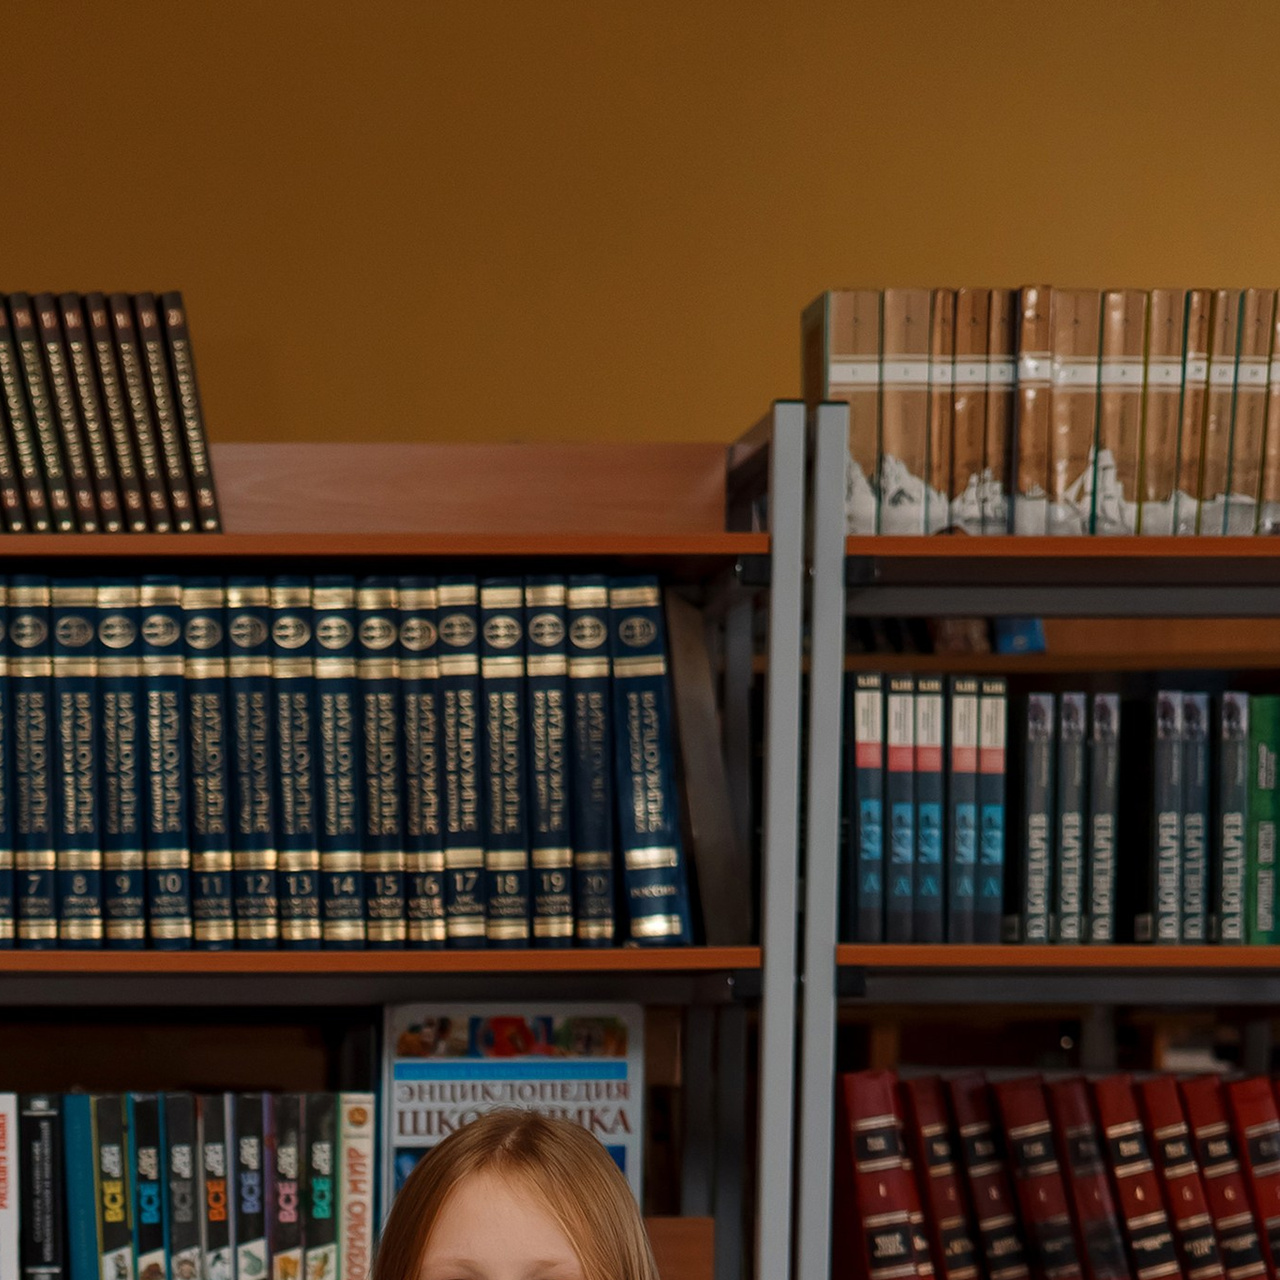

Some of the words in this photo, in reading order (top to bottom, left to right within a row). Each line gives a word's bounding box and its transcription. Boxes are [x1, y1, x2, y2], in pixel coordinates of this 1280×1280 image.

[29, 692, 48, 834] ЭНЦИКЛОПЕДИЯ
[76, 692, 95, 834] ЭНЦИКЛОПЕДИЯ
[117, 692, 137, 834] ЭНЦИКЛОПЕДИЯ
[161, 691, 181, 833] ЭНЦИКЛОПЕДИЯ
[202, 692, 226, 834] ЭНЦИКЛОПЕДИЯ
[250, 691, 270, 834] ЭНЦИКЛОПЕДИЯ
[293, 692, 312, 834] ЭНЦИКЛОПЕДИЯ
[334, 692, 356, 834] ЭНЦИКЛОПЕДИЯ
[377, 693, 399, 835] ЭНЦИКЛОПЕДИЯ
[419, 693, 439, 836] ЭНЦИКЛОПЕДИЯ
[457, 689, 477, 832] ЭНЦИКЛОПЕДИЯ
[502, 692, 521, 834] ЭНЦИКЛОПЕДИЯ
[546, 690, 565, 833] ЭНЦИКЛОПЕДИЯ
[641, 691, 663, 833] ЭНЦИКЛОПЕДИЯ
[28, 874, 41, 894] 7
[72, 873, 87, 894] 8
[115, 873, 130, 893] 9
[159, 872, 181, 894] 10
[201, 876, 220, 894] 11
[247, 875, 271, 894] 12
[287, 874, 312, 894] 13
[331, 875, 355, 894] 14
[375, 874, 398, 895] 15
[414, 875, 438, 896] 16
[454, 870, 478, 893] 17
[496, 873, 519, 894] 18
[541, 872, 565, 894] 19
[1028, 915, 1047, 939] Ю.
[1060, 915, 1081, 939] Ю.
[1092, 915, 1113, 939] Ю.
[1157, 915, 1179, 939] Ю.
[1183, 915, 1205, 939] Ю.
[1222, 915, 1245, 939] Ю.
[397, 1081, 629, 1101] ЭНЦИКЛОПЕДИЯ
[347, 1147, 368, 1195] МИР
[102, 1181, 124, 1222] ВСЕ
[139, 1182, 158, 1223] ВСЕ
[172, 1181, 192, 1221] ВСЕ
[205, 1180, 227, 1220] ВСЕ
[241, 1171, 260, 1213] ВСЕ
[277, 1181, 297, 1222] ВСЕ
[311, 1177, 331, 1218] ВСЕ
